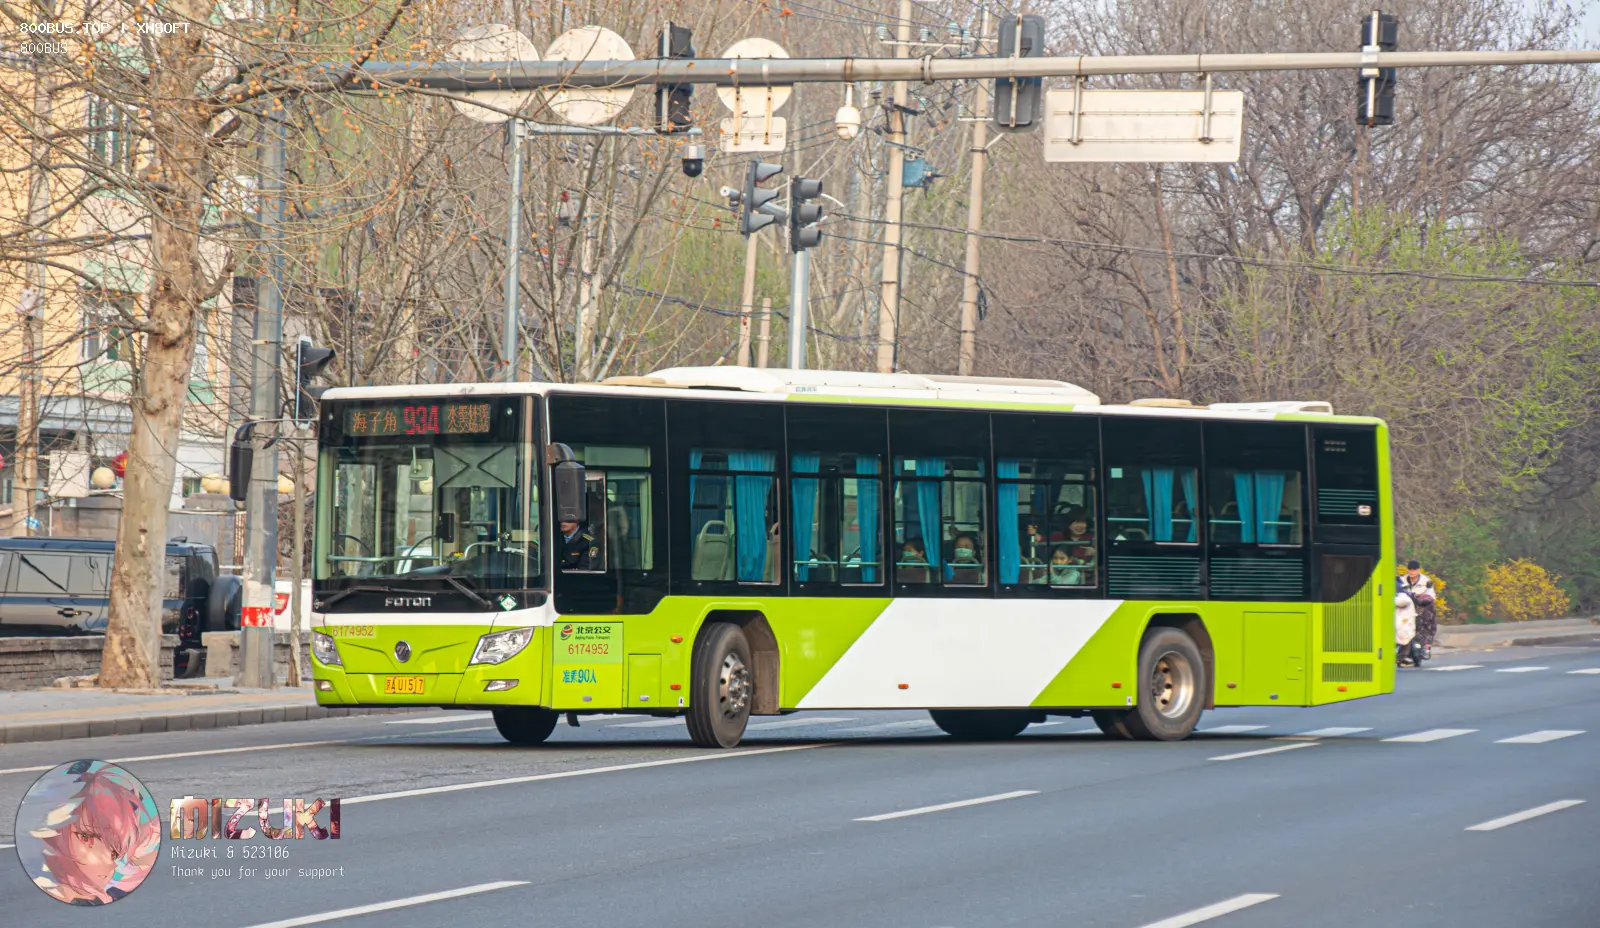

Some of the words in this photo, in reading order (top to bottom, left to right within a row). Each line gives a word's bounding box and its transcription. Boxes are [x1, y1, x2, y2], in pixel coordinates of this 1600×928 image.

[352, 410, 397, 433] 海子角
[403, 405, 440, 435] 934
[385, 597, 432, 607] FOTON
[332, 626, 375, 637] 6174952
[576, 626, 611, 634] 北京公交
[568, 643, 609, 655] 6174952
